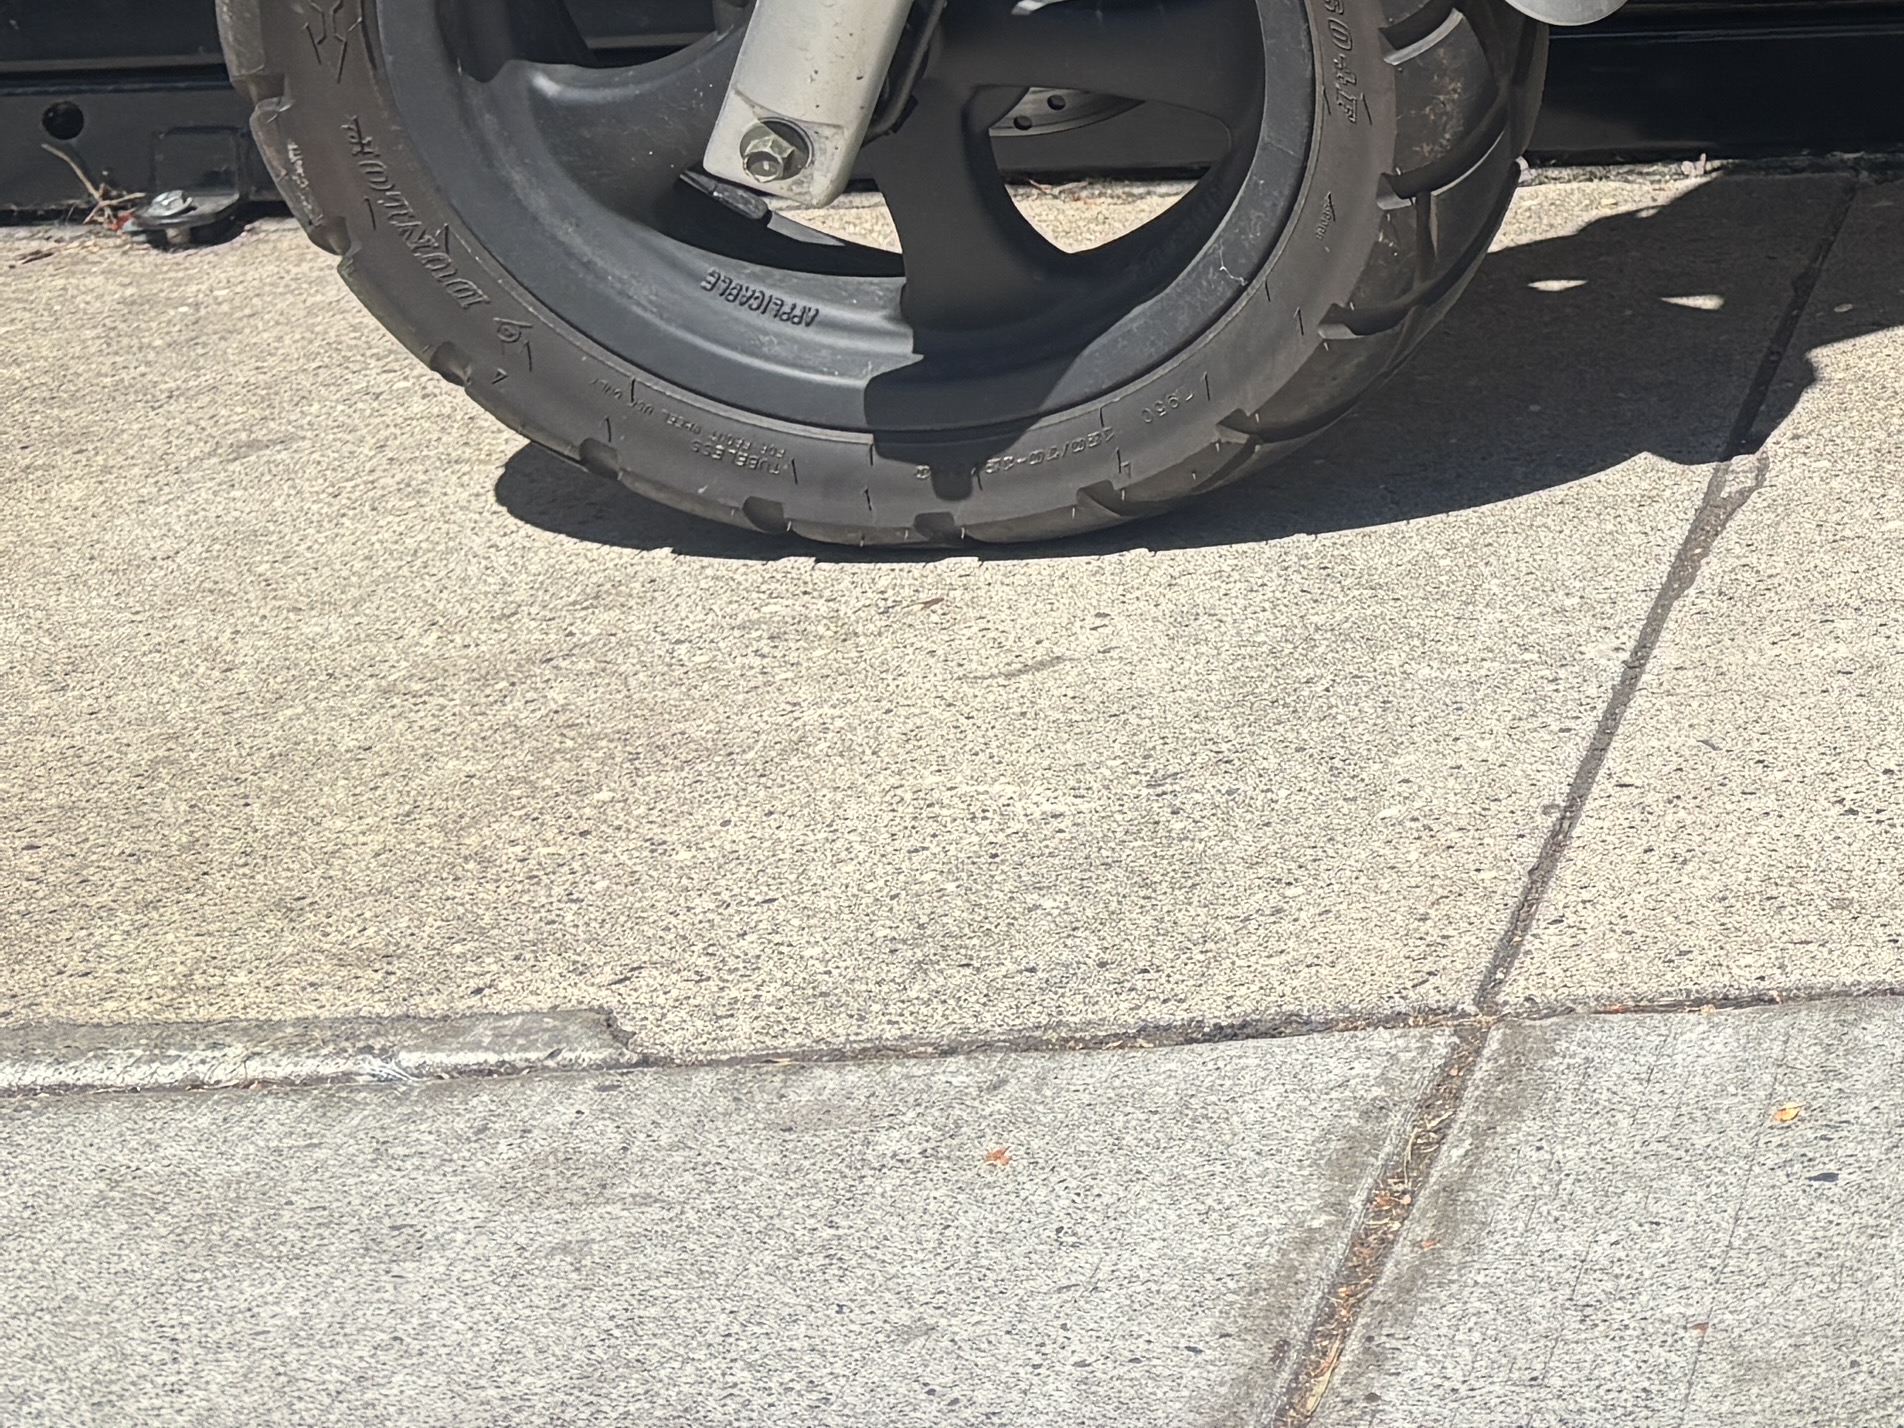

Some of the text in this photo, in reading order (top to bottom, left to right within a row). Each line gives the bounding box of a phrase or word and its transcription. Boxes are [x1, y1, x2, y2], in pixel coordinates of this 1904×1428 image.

[340, 121, 491, 309] DUNLOP
[700, 268, 820, 328] APPLICABLE
[689, 440, 781, 475] TUBELESS
